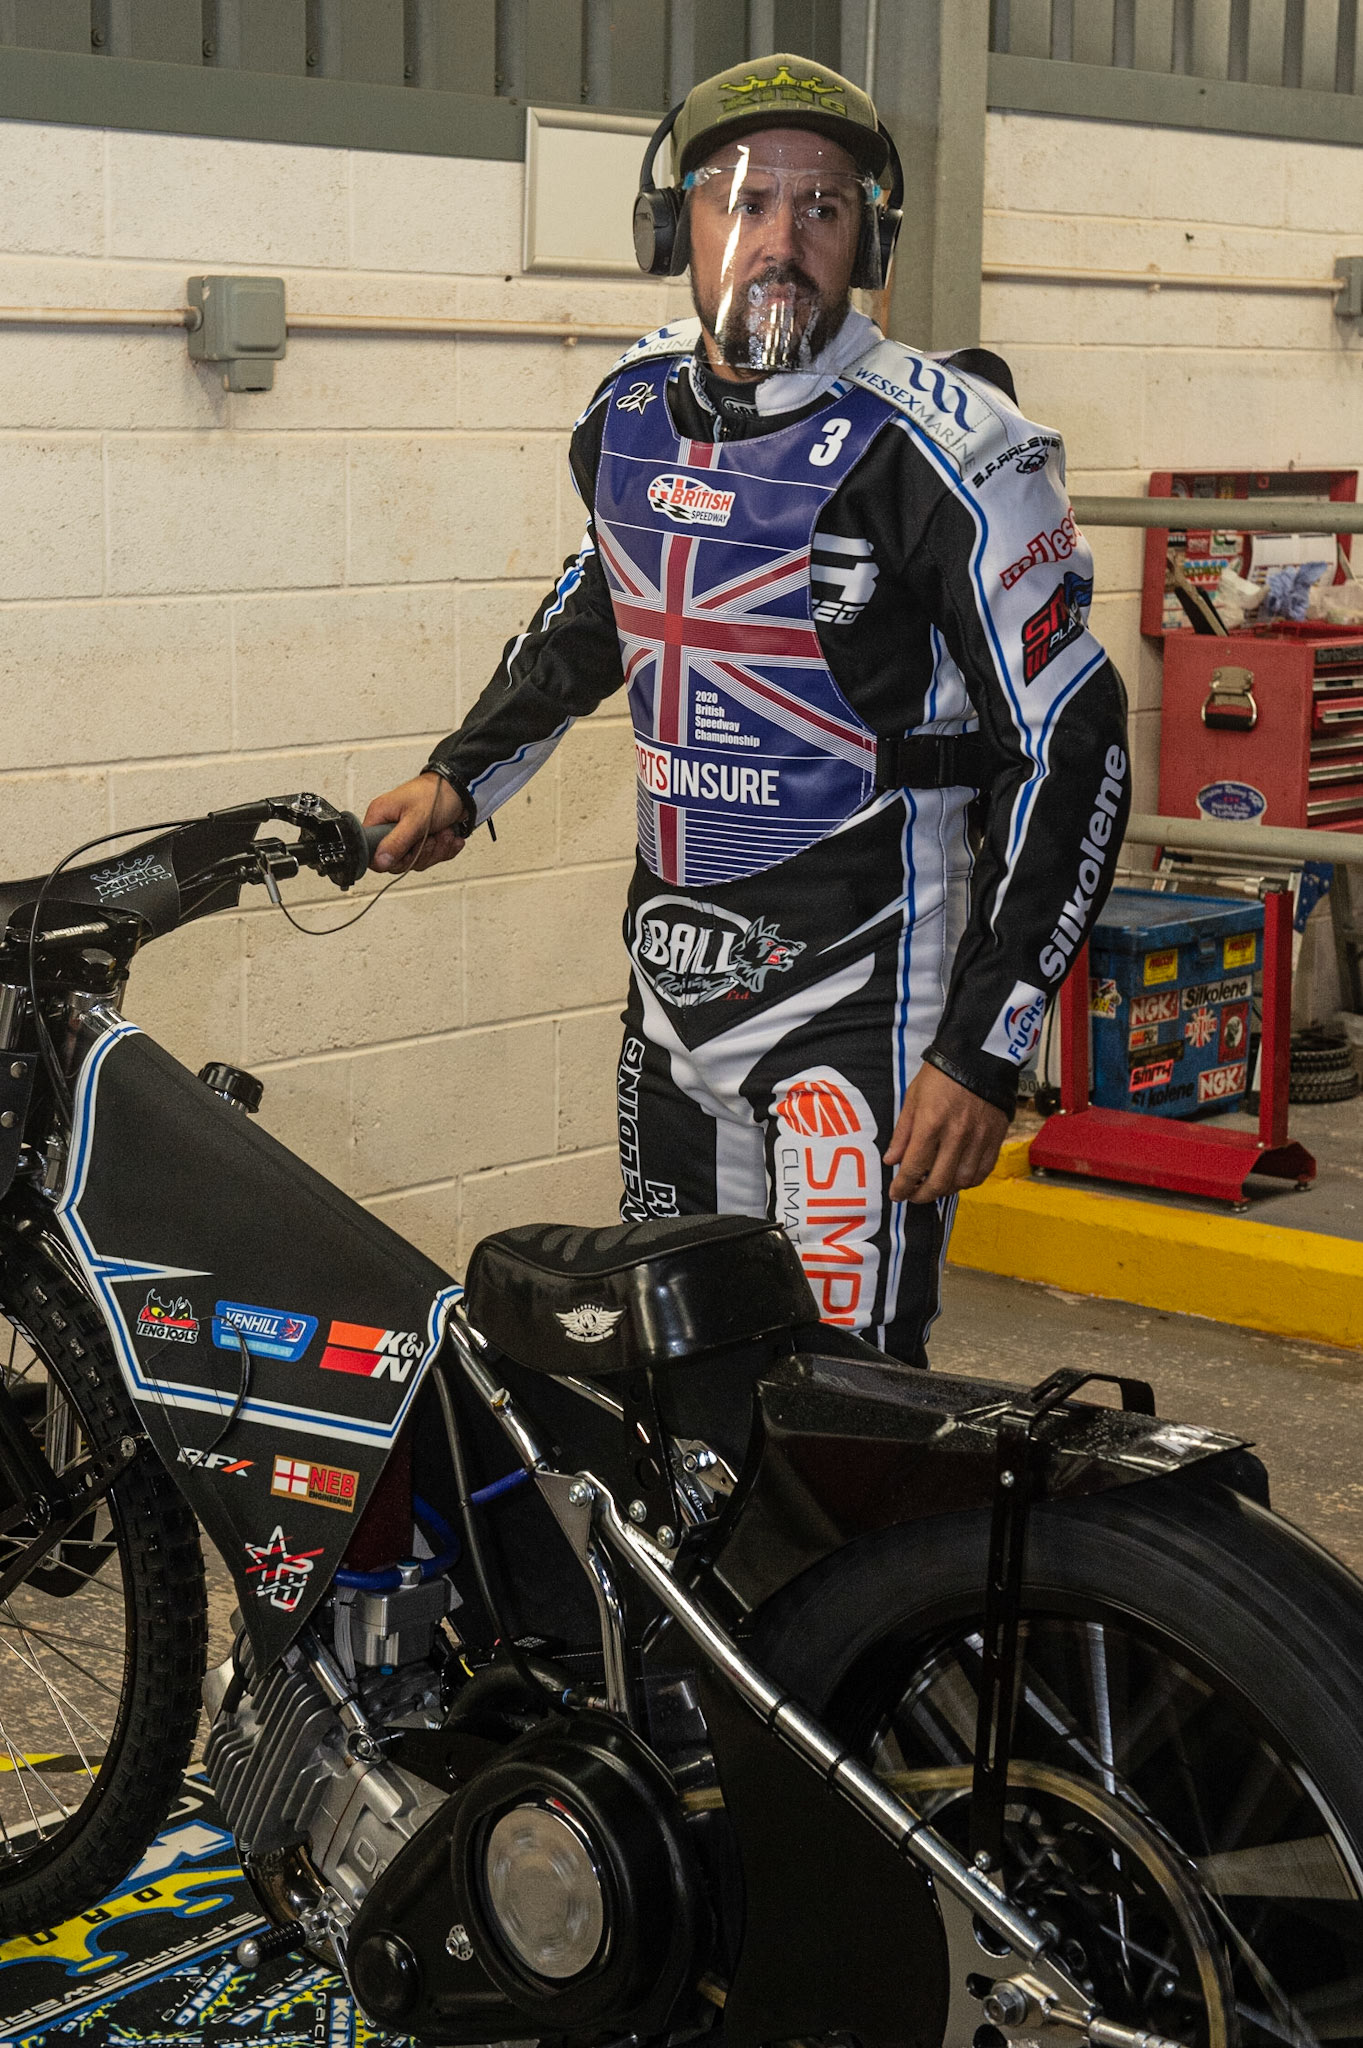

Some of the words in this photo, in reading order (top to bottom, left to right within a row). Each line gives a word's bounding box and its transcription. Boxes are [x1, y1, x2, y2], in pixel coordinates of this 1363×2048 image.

[809, 418, 852, 467] 3
[670, 486, 733, 512] BRITISH
[690, 510, 728, 524] SPEEDWAY
[695, 690, 718, 704] 2020
[695, 703, 725, 718] British
[694, 715, 740, 733] Speedway
[694, 729, 761, 748] Championship
[673, 758, 781, 807] INSURE
[1039, 744, 1127, 984] Silkolene
[95, 865, 166, 897] KING
[644, 919, 741, 974] BALL
[1185, 980, 1248, 1008] Silkolene
[1131, 994, 1171, 1027] NGK
[1008, 995, 1045, 1060] FUCHS
[1200, 1067, 1240, 1100] NGK
[221, 1311, 279, 1337] VENHILL
[177, 1447, 255, 1477] RFX
[309, 1466, 356, 1498] NEB
[174, 1963, 242, 2026] KING
[228, 1967, 333, 2026] KING
